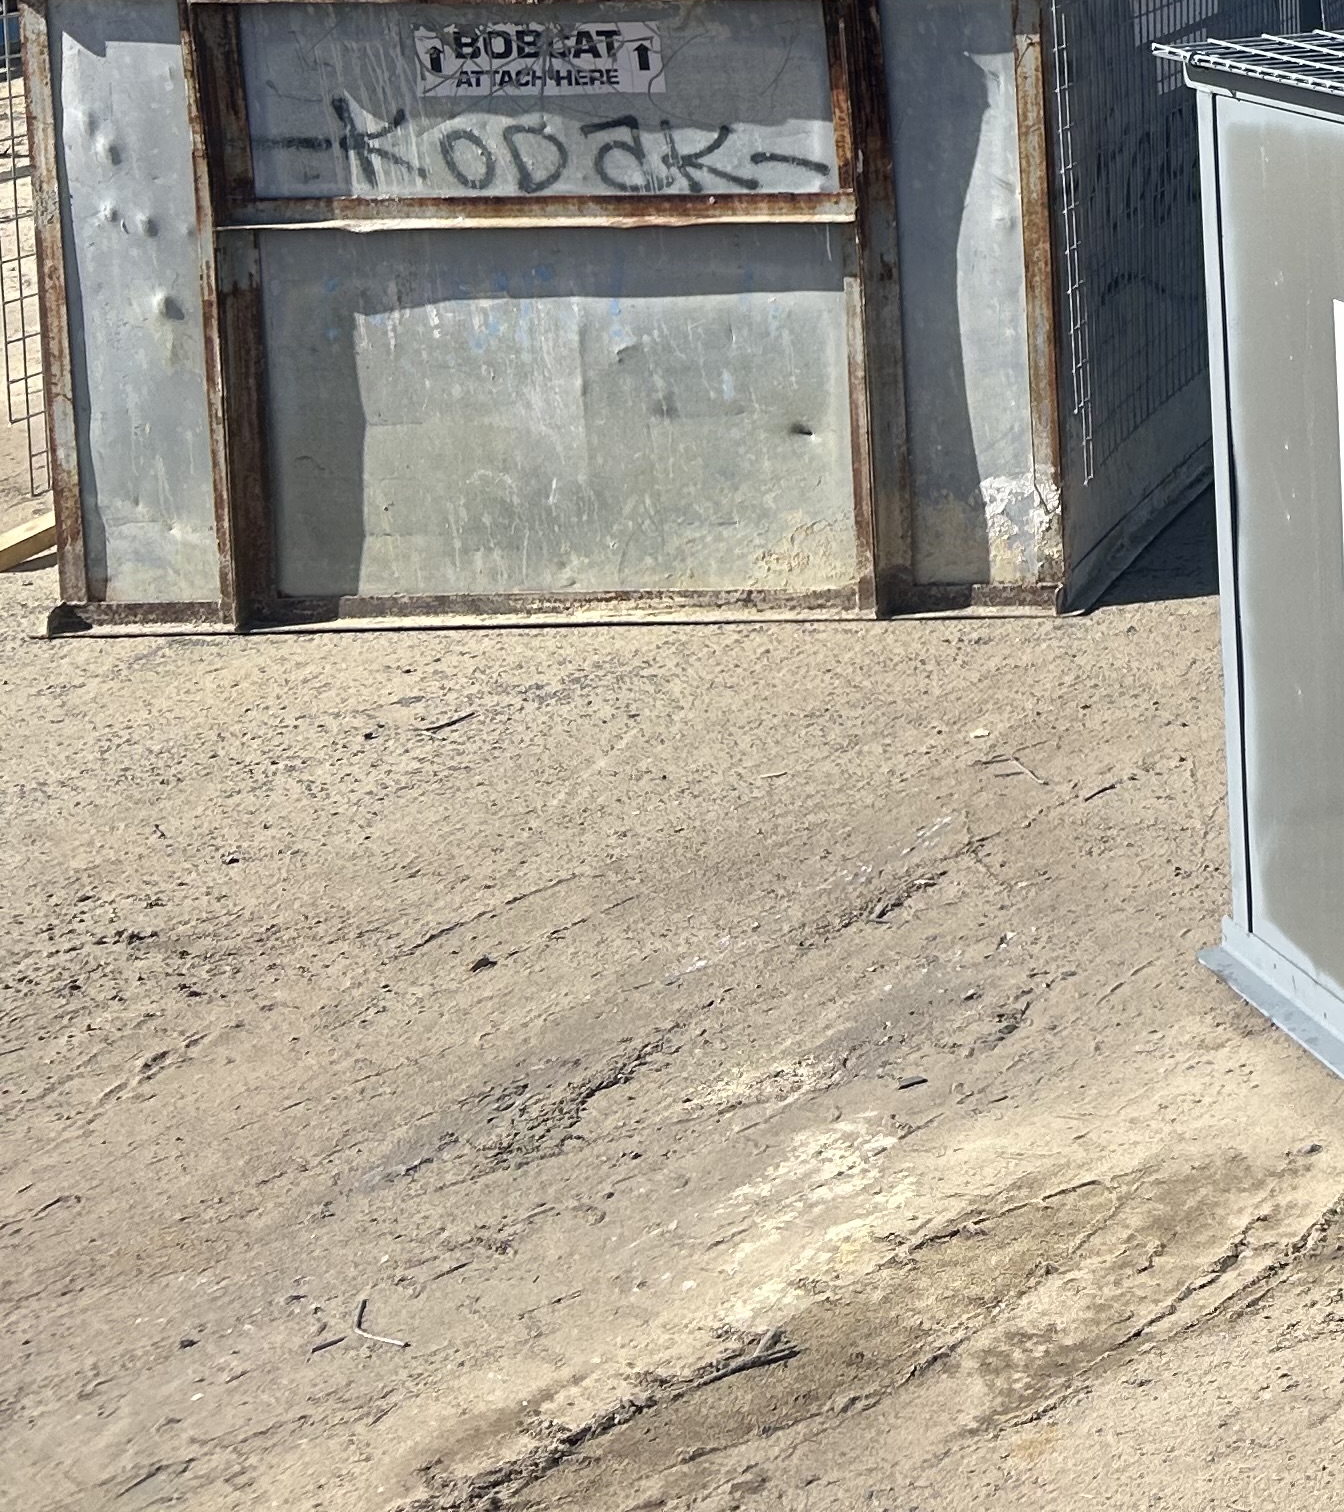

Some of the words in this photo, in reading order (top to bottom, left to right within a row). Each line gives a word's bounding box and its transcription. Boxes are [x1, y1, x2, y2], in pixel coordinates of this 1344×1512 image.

[454, 29, 622, 59] BOBCAT
[455, 69, 547, 88] ATTACH
[555, 68, 620, 87] HERE
